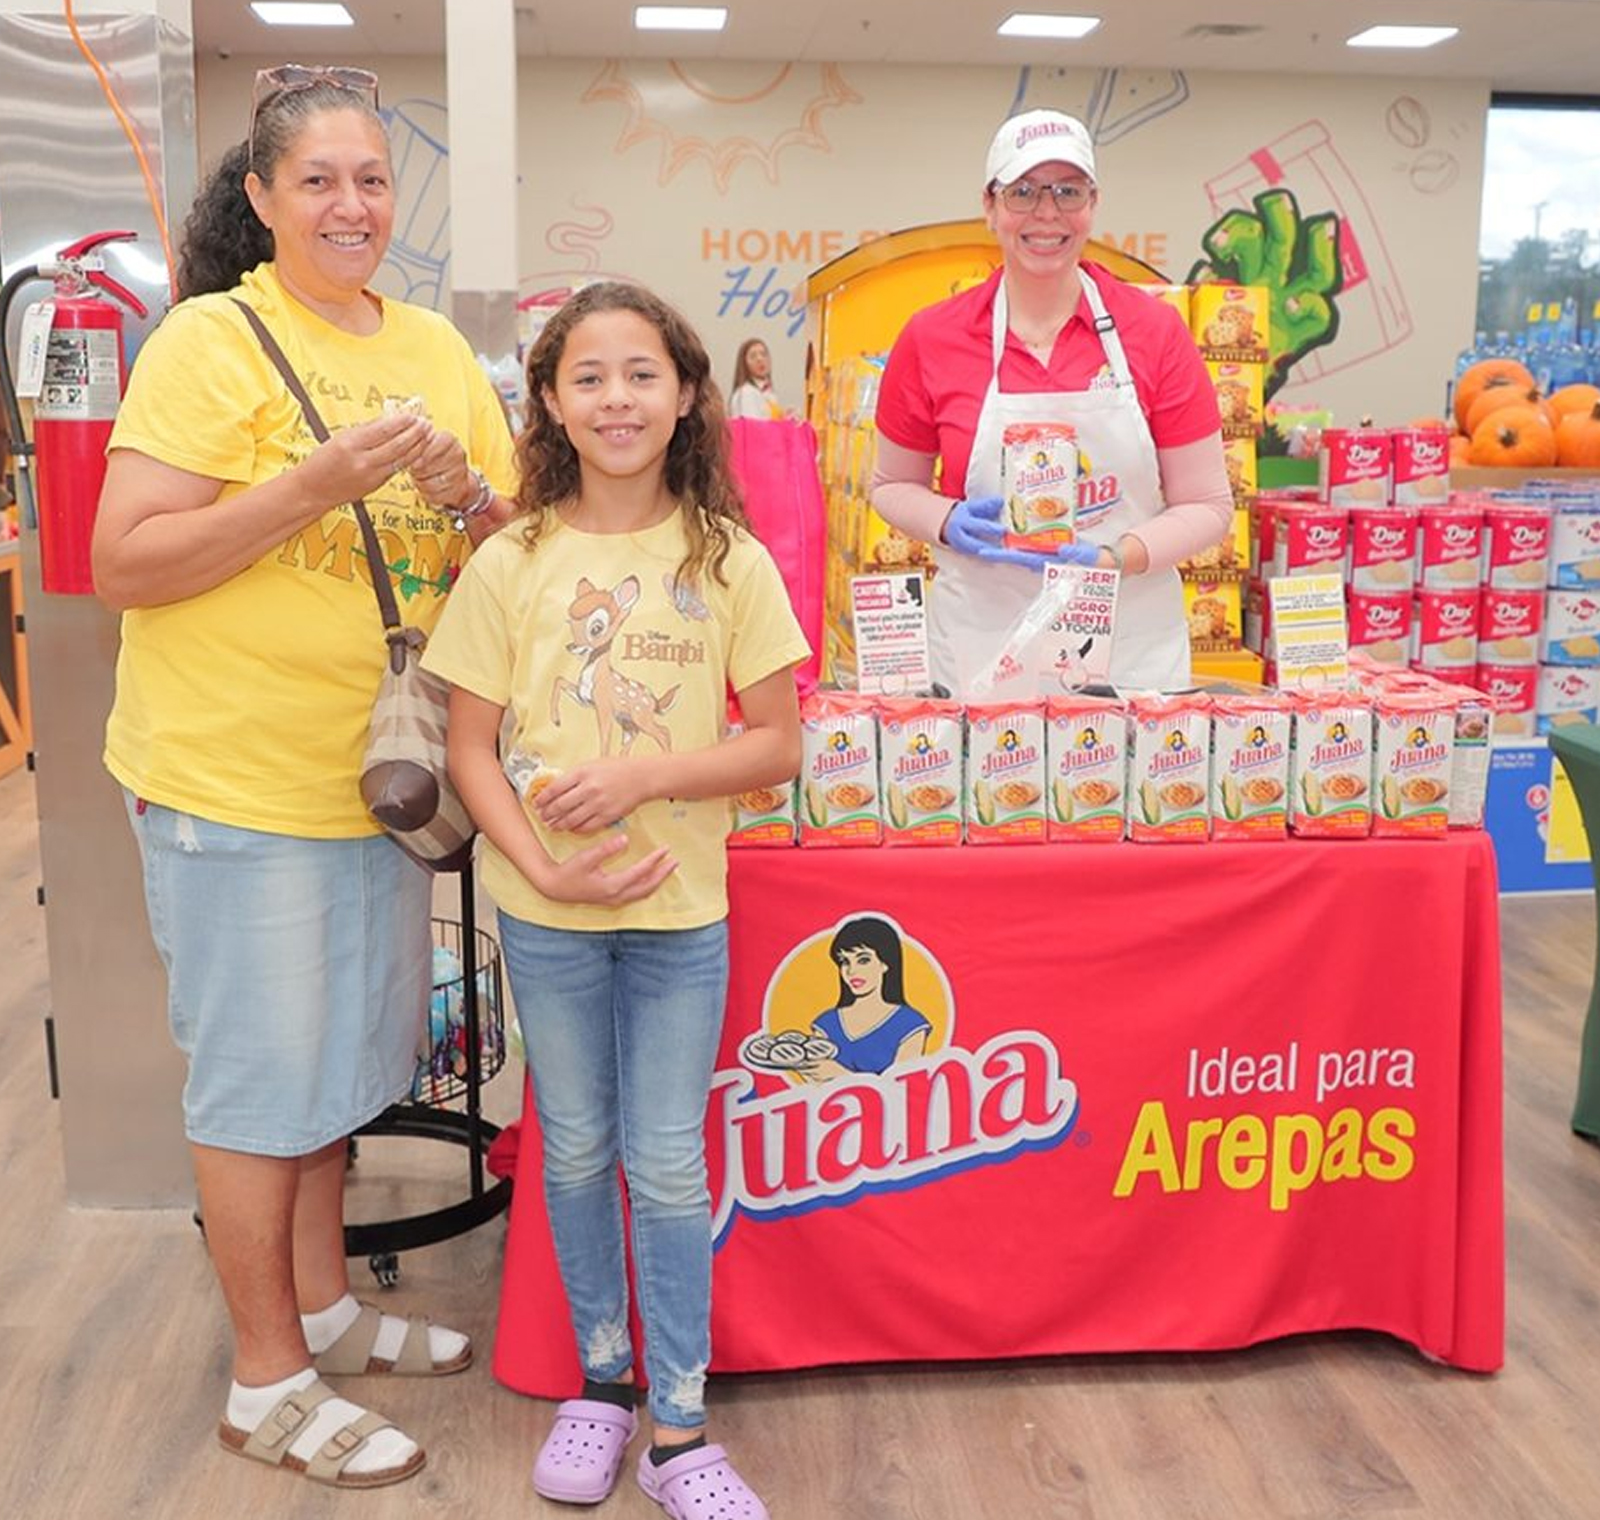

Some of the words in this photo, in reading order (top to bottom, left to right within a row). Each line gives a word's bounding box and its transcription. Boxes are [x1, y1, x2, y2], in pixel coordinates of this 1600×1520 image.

[1016, 122, 1071, 149] Juana
[702, 228, 844, 263] HOME
[1016, 465, 1066, 491] Juana
[382, 510, 400, 528] for
[406, 515, 445, 533] being
[278, 518, 466, 598] MOM
[1058, 612, 1111, 625] LIENTE
[1066, 600, 1112, 614] LIGRO!
[1066, 623, 1111, 636] TOCAR
[621, 633, 704, 668] Bambi
[813, 746, 869, 776] Juana
[893, 748, 950, 779] Juana
[981, 744, 1037, 775] Juana
[1060, 743, 1116, 773] Juana
[1149, 744, 1203, 775] Juana
[1229, 743, 1283, 770] Juana
[1309, 738, 1364, 767] Juana
[1390, 743, 1447, 770] Juana
[1187, 1042, 1298, 1097] Ideal
[1317, 1048, 1415, 1103] para
[702, 1042, 1065, 1217] Juana
[1112, 1101, 1416, 1211] Arepas
